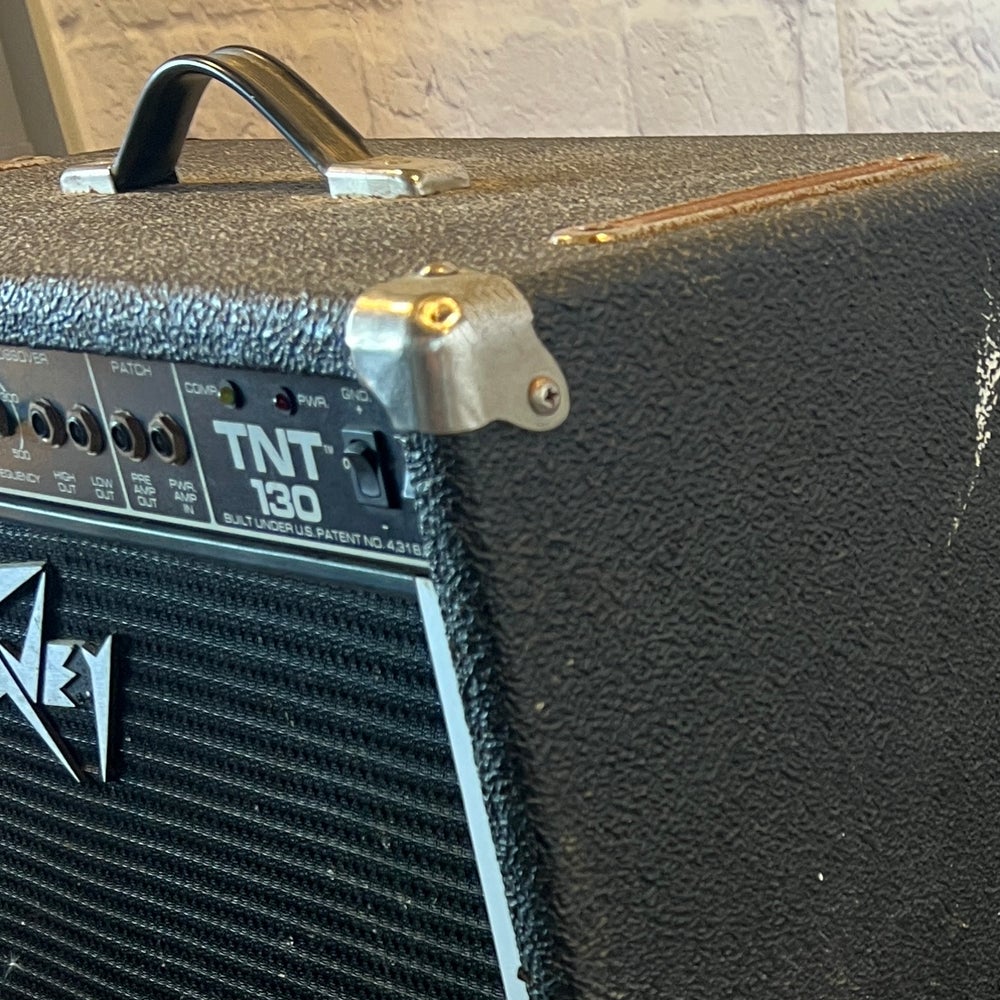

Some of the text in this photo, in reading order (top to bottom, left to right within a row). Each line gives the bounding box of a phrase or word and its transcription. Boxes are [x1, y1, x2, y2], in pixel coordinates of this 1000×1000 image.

[111, 361, 152, 376] PATCH
[11, 448, 31, 461] 500
[212, 419, 322, 481] TNT
[53, 470, 76, 483] HIGH
[91, 476, 114, 488] LOW
[131, 472, 152, 486] PRE
[57, 482, 76, 495] OUT
[95, 488, 114, 501] OUT
[134, 484, 156, 496] AMP
[137, 495, 157, 508] OUT
[174, 491, 198, 503] AMP
[251, 479, 322, 523] 130
[183, 503, 195, 515] IN
[223, 512, 253, 527] BUILT
[255, 518, 294, 534] UNDER
[316, 527, 361, 545] PATENT
